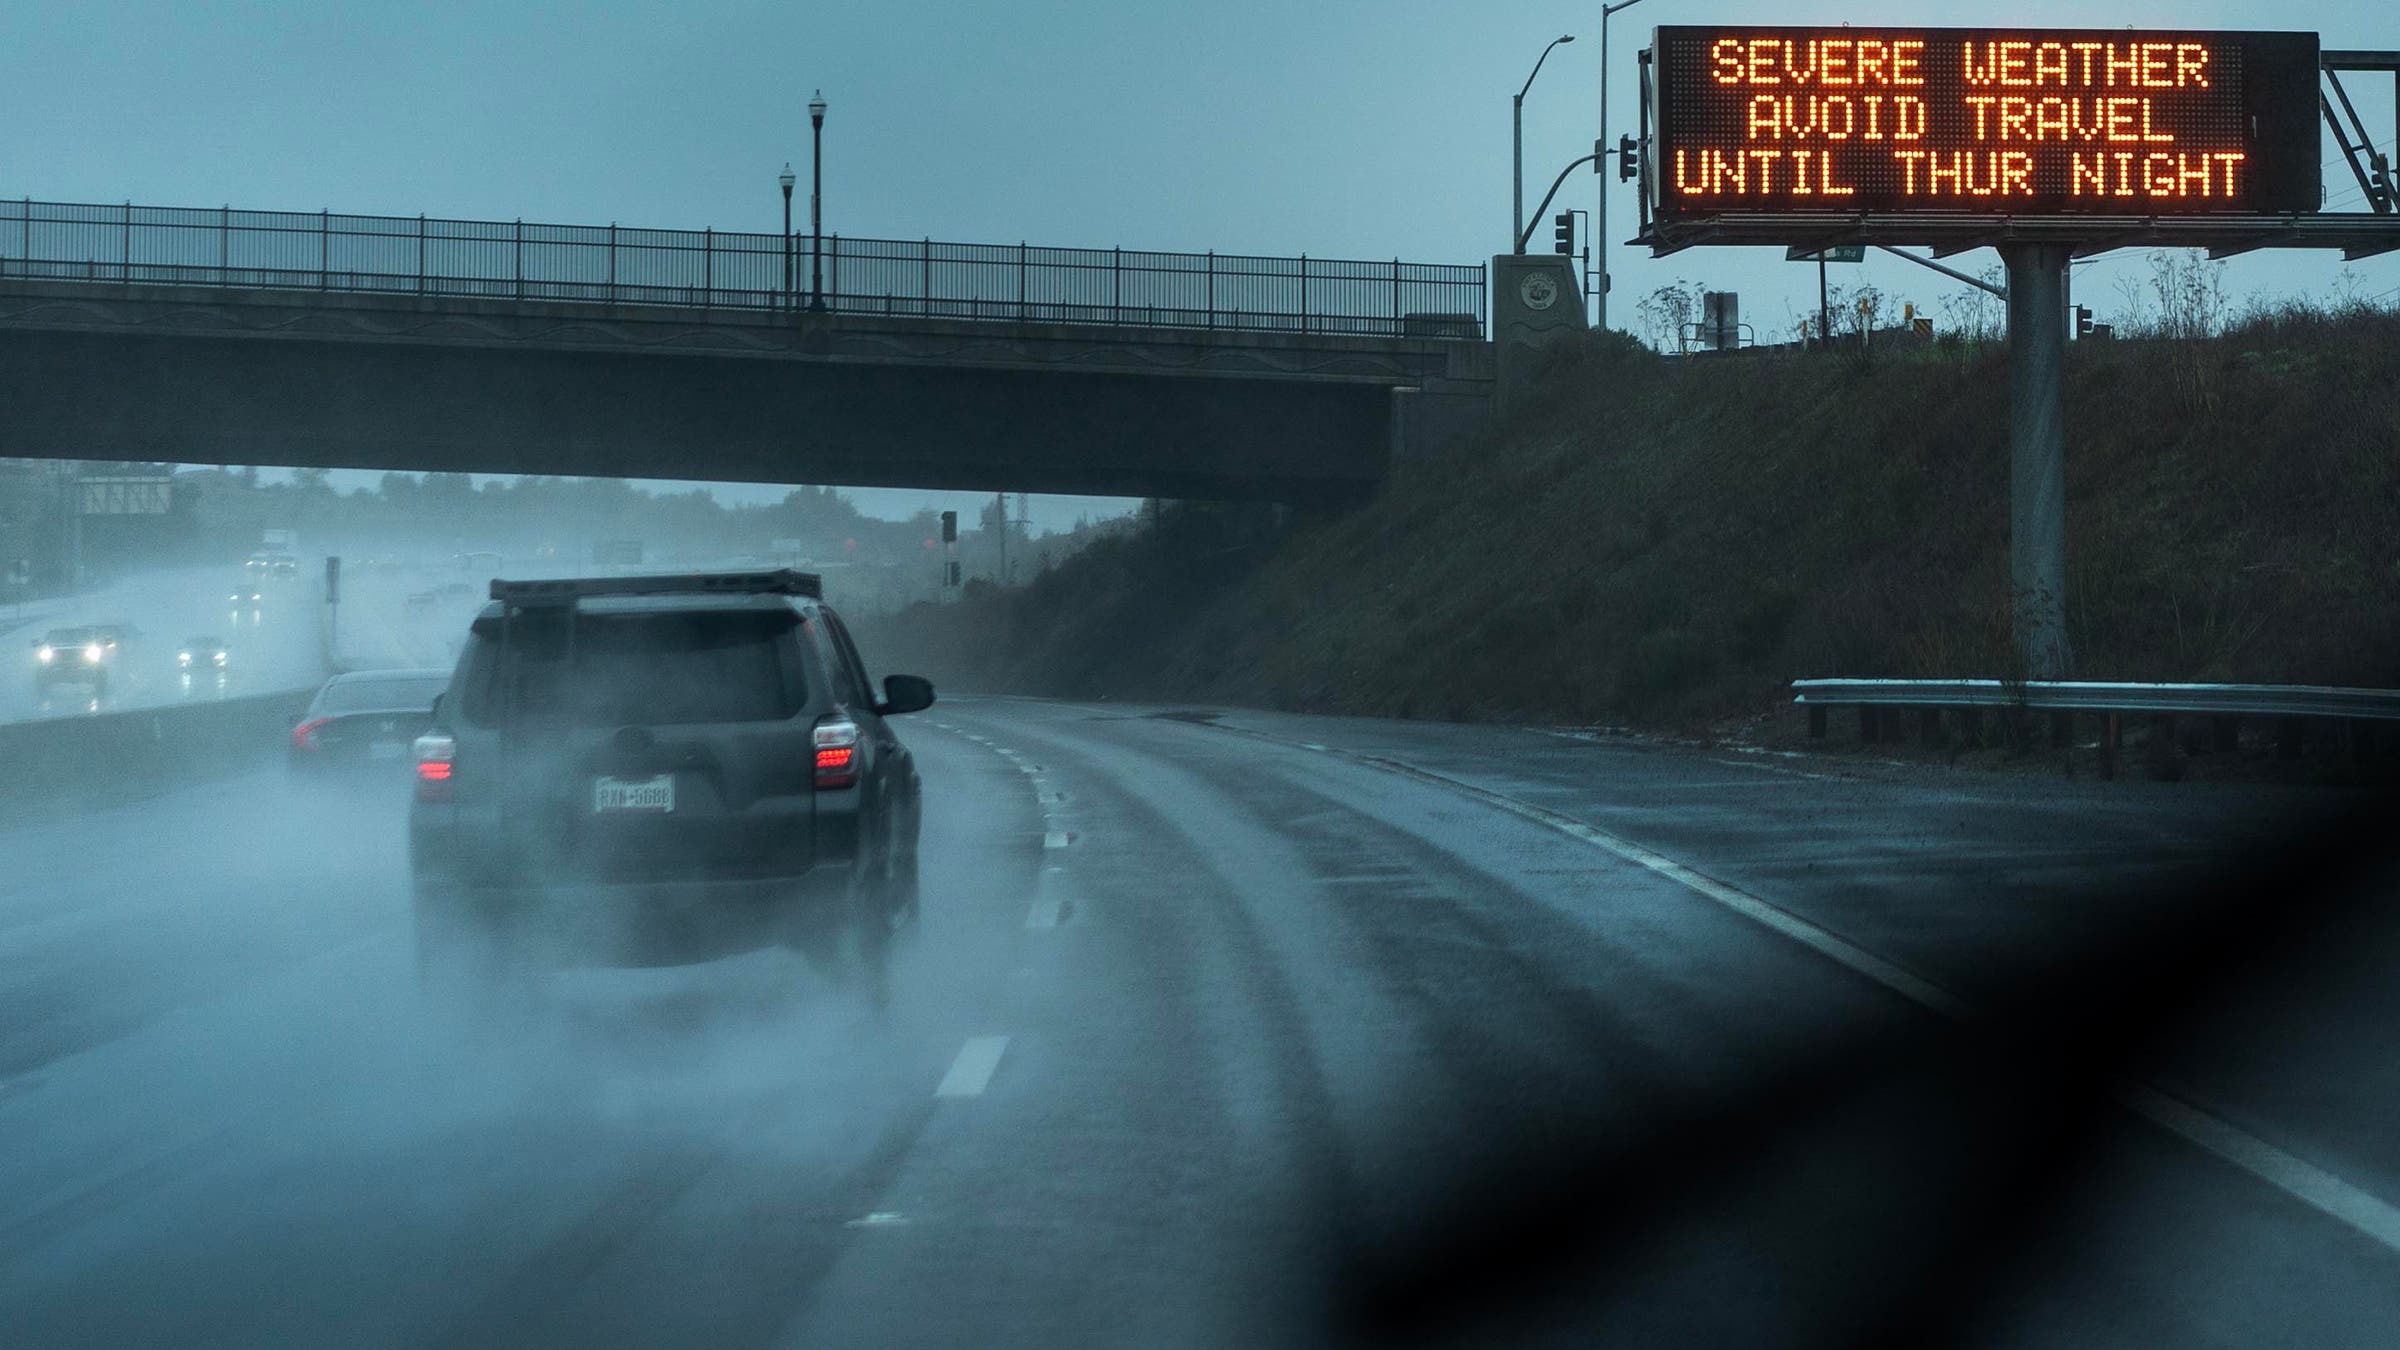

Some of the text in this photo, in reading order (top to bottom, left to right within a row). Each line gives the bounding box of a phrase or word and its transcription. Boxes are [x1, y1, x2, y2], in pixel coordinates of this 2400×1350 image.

[1712, 40, 2208, 88] SEVERE WEATHER
[1748, 95, 2174, 141] AVOID TRAVEL
[1677, 149, 2244, 196] UNTIL THUR NIGHT
